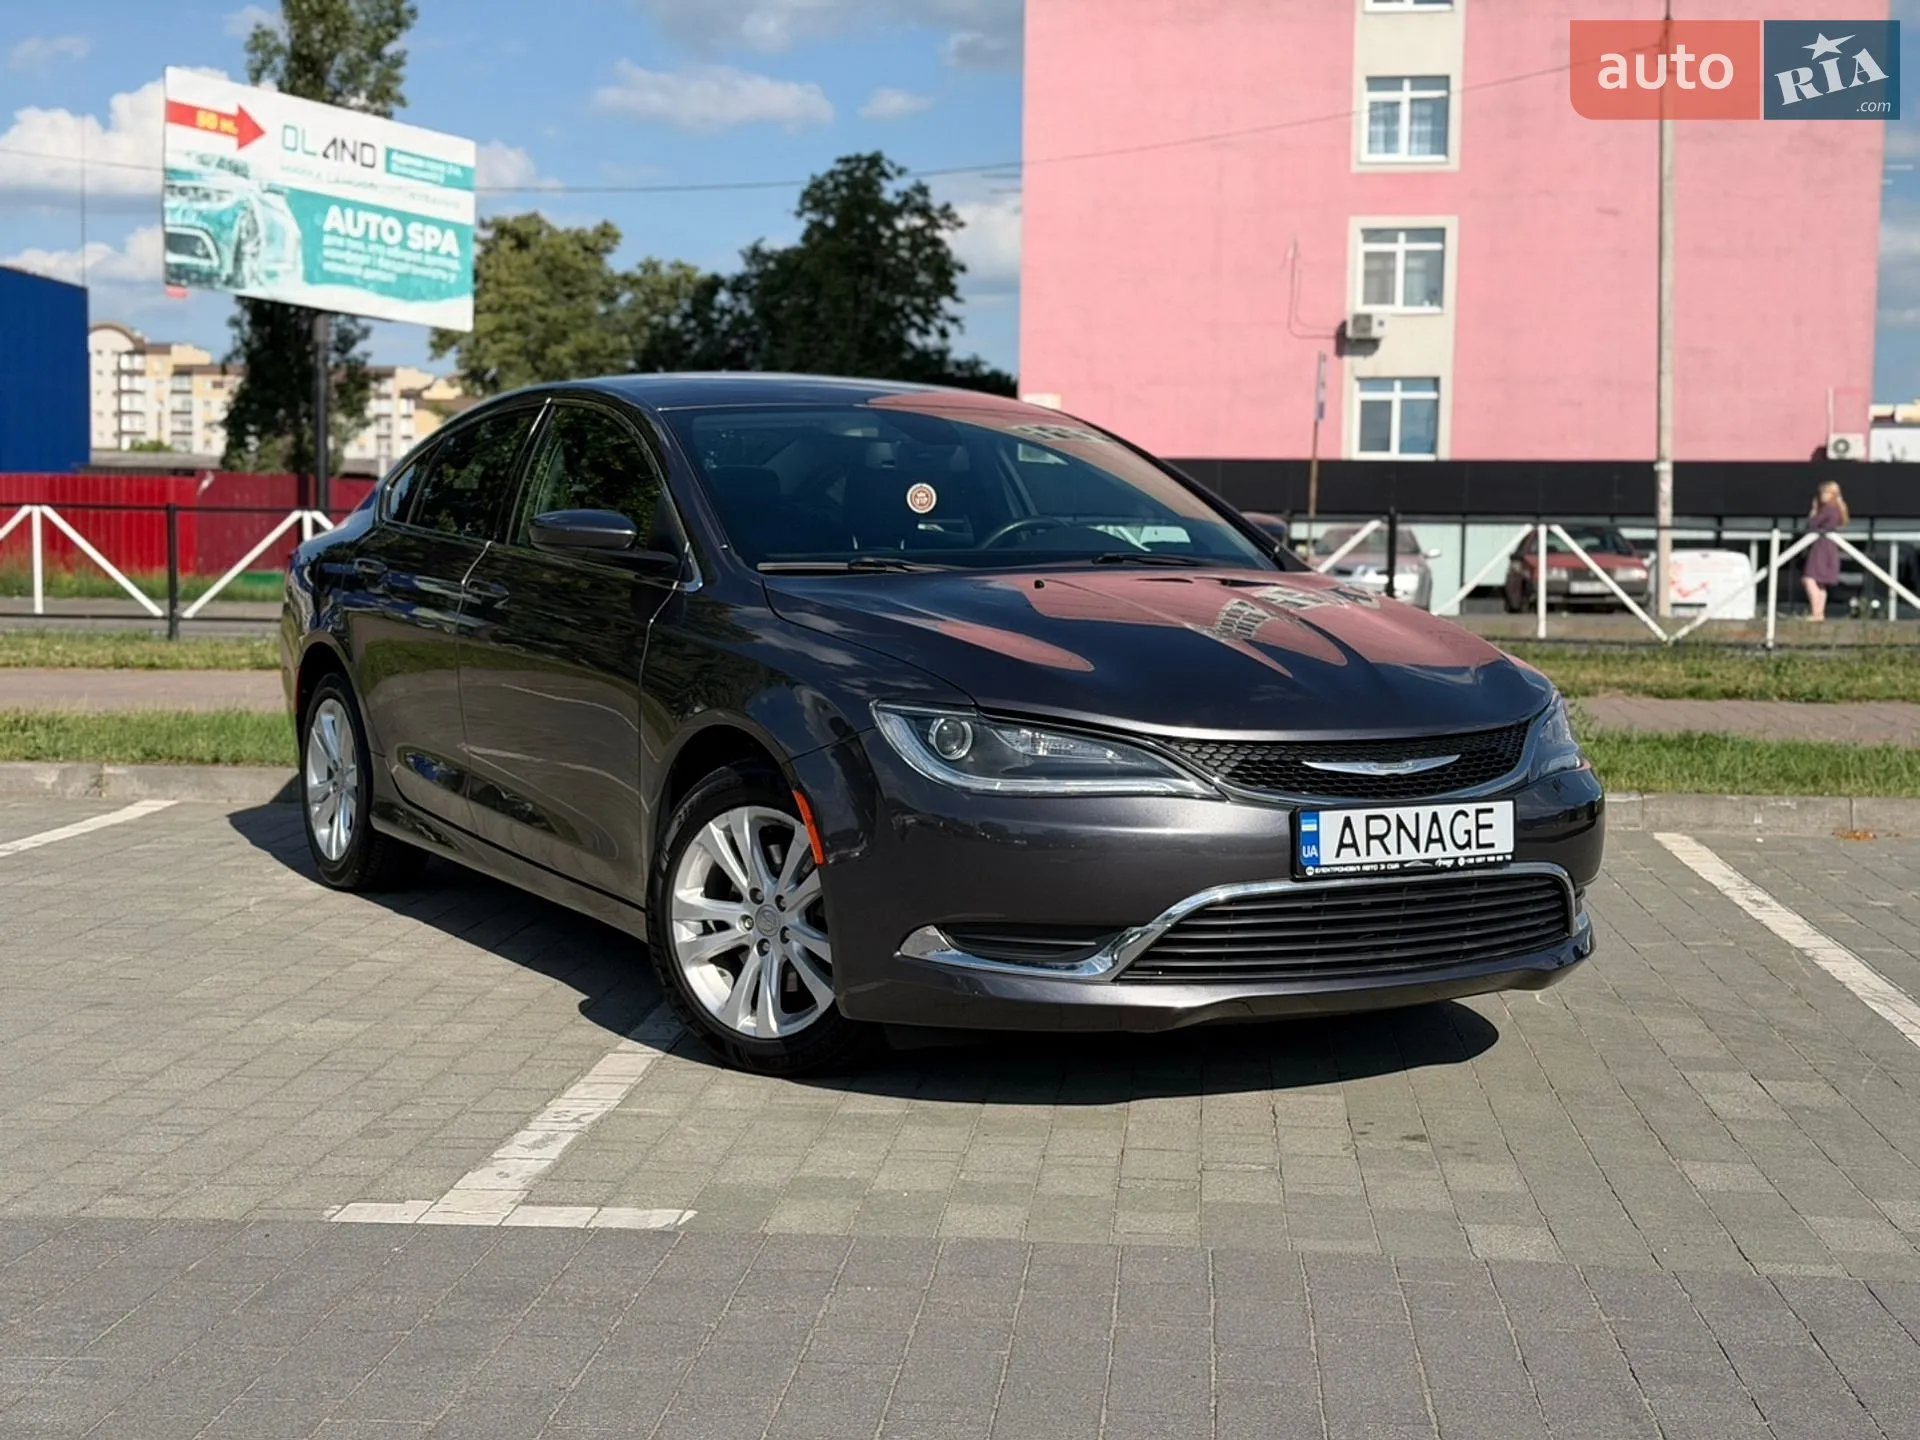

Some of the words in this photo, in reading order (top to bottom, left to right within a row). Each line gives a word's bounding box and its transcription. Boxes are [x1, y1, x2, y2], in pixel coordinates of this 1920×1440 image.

[323, 204, 403, 246] AUTO
[407, 221, 460, 257] SPA
[1302, 845, 1318, 858] UA
[1334, 807, 1496, 858] ARNAGE
